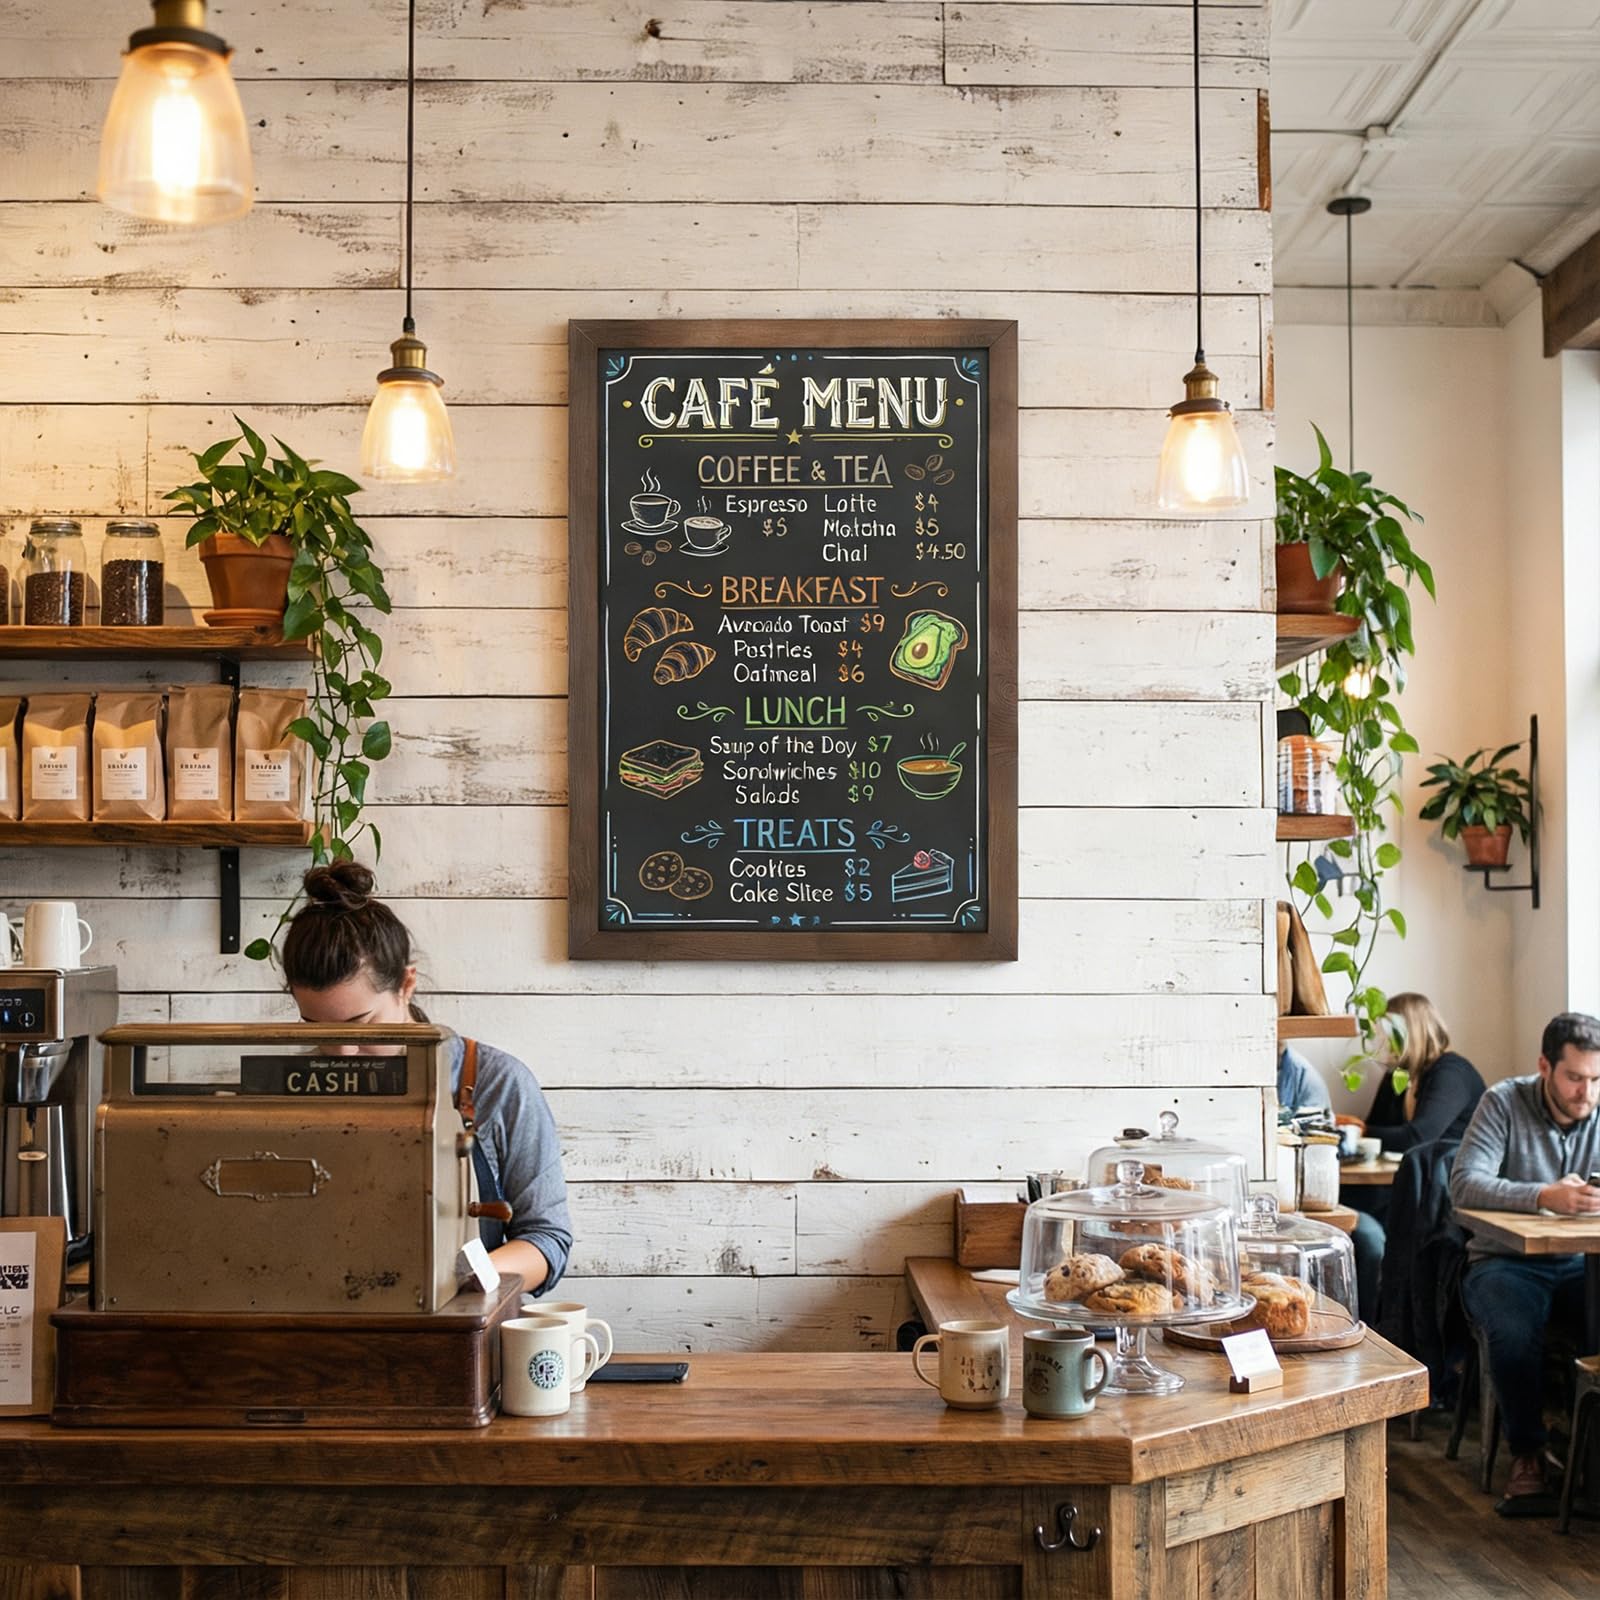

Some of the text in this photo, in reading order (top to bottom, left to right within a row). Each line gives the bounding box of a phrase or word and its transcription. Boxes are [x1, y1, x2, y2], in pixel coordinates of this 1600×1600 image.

[640, 363, 948, 429] CAFÉ MENU
[699, 455, 891, 484] COFFEE & TEA
[915, 492, 938, 512] $4
[763, 518, 787, 536] $5
[915, 517, 939, 536] $5
[722, 576, 884, 604] BREAKFAST
[860, 613, 885, 632] $9
[838, 640, 863, 658] $4
[839, 664, 864, 682] $6
[746, 696, 845, 725] LUNCH
[759, 735, 779, 754] of
[786, 736, 814, 754] the
[868, 735, 892, 752] $7
[849, 761, 881, 779] $10
[848, 785, 873, 803] $9
[734, 819, 855, 848] TREATS
[845, 858, 870, 877] $2
[730, 882, 778, 902] Cake
[845, 881, 872, 901] $5
[287, 1072, 359, 1093] CASH
